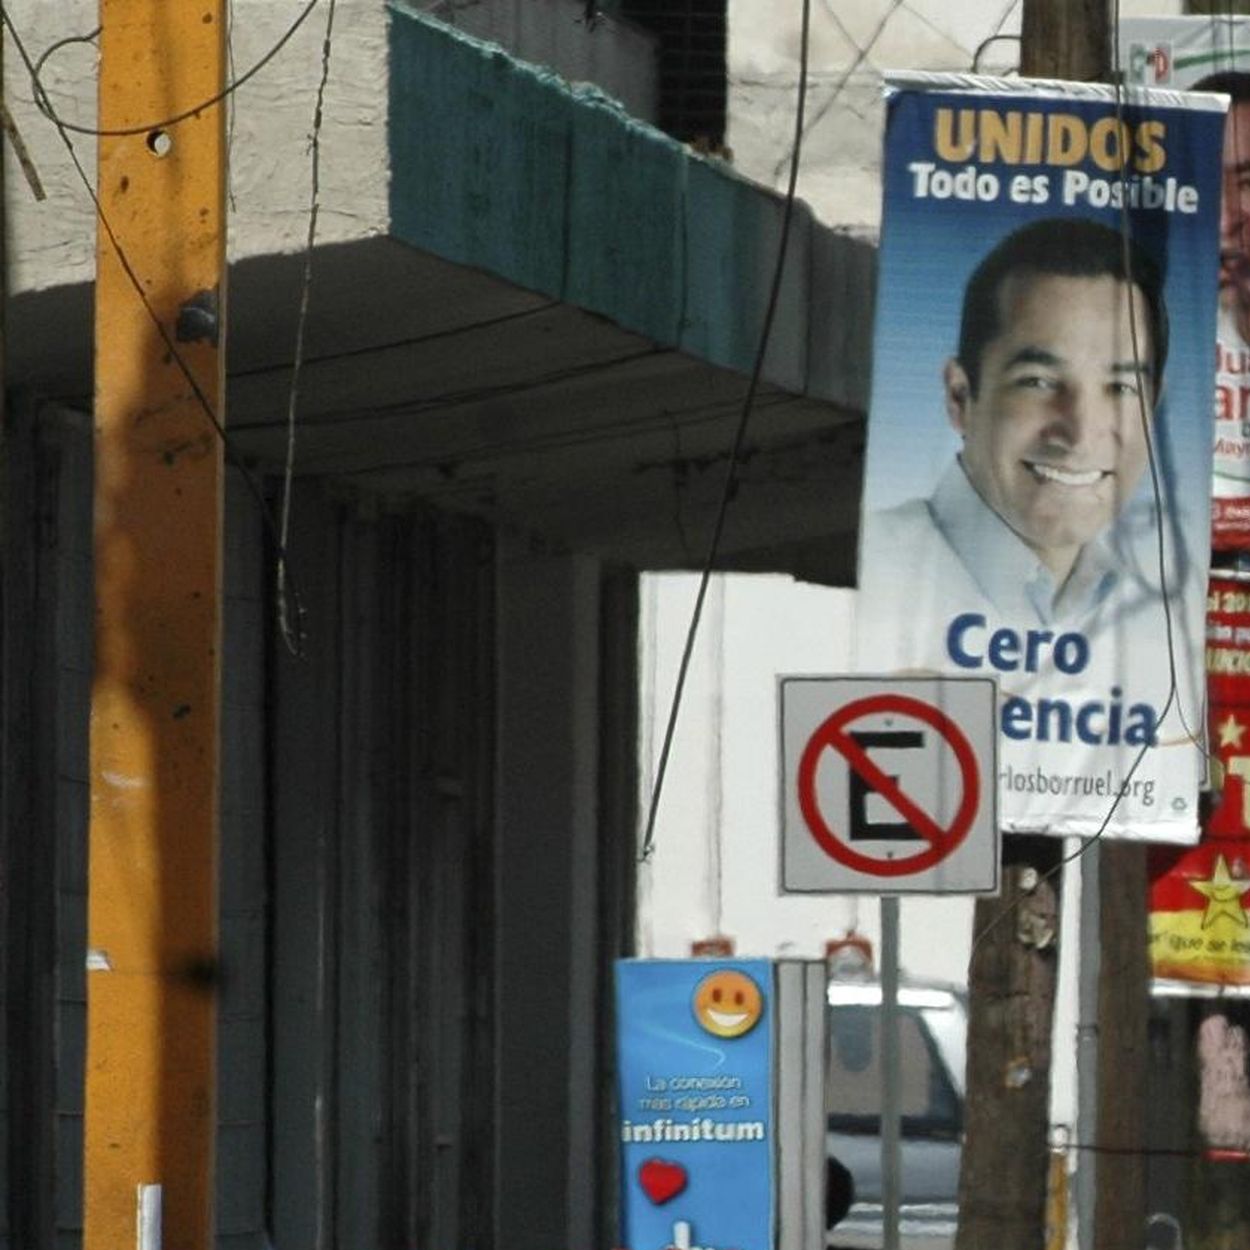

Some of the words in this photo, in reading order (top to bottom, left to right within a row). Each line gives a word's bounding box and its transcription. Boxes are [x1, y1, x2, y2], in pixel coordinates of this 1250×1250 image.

[935, 108, 1166, 173] UNIDOS
[909, 162, 998, 202] Todo
[1010, 174, 1050, 204] es
[1062, 169, 1198, 213] Posible
[946, 612, 1091, 675] Cero
[646, 1075, 668, 1092] La
